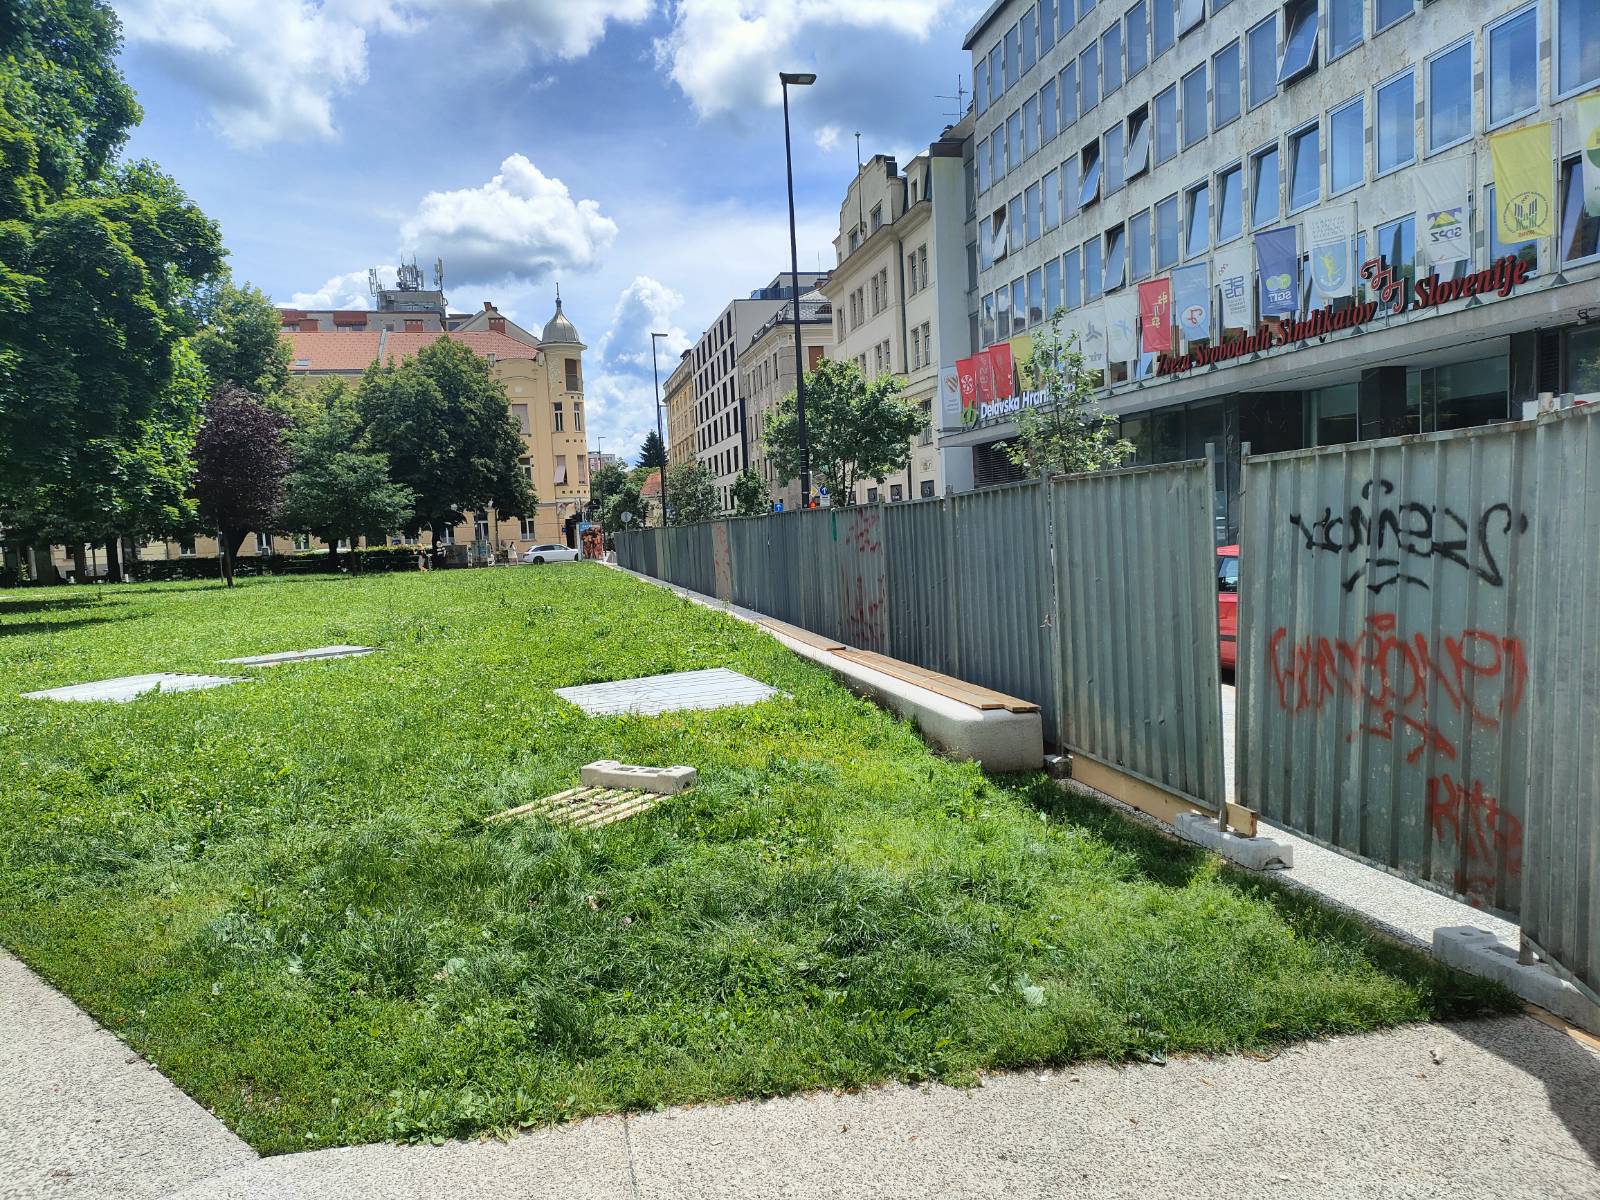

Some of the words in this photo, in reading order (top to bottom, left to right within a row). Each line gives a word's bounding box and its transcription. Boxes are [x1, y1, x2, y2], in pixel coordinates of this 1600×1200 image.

[1155, 353, 1193, 377] Zveza
[1195, 325, 1272, 368] Svobodnih
[1276, 300, 1378, 347] Sindikatov
[1413, 255, 1531, 310] Slovenije
[980, 395, 1020, 419] Delavska
